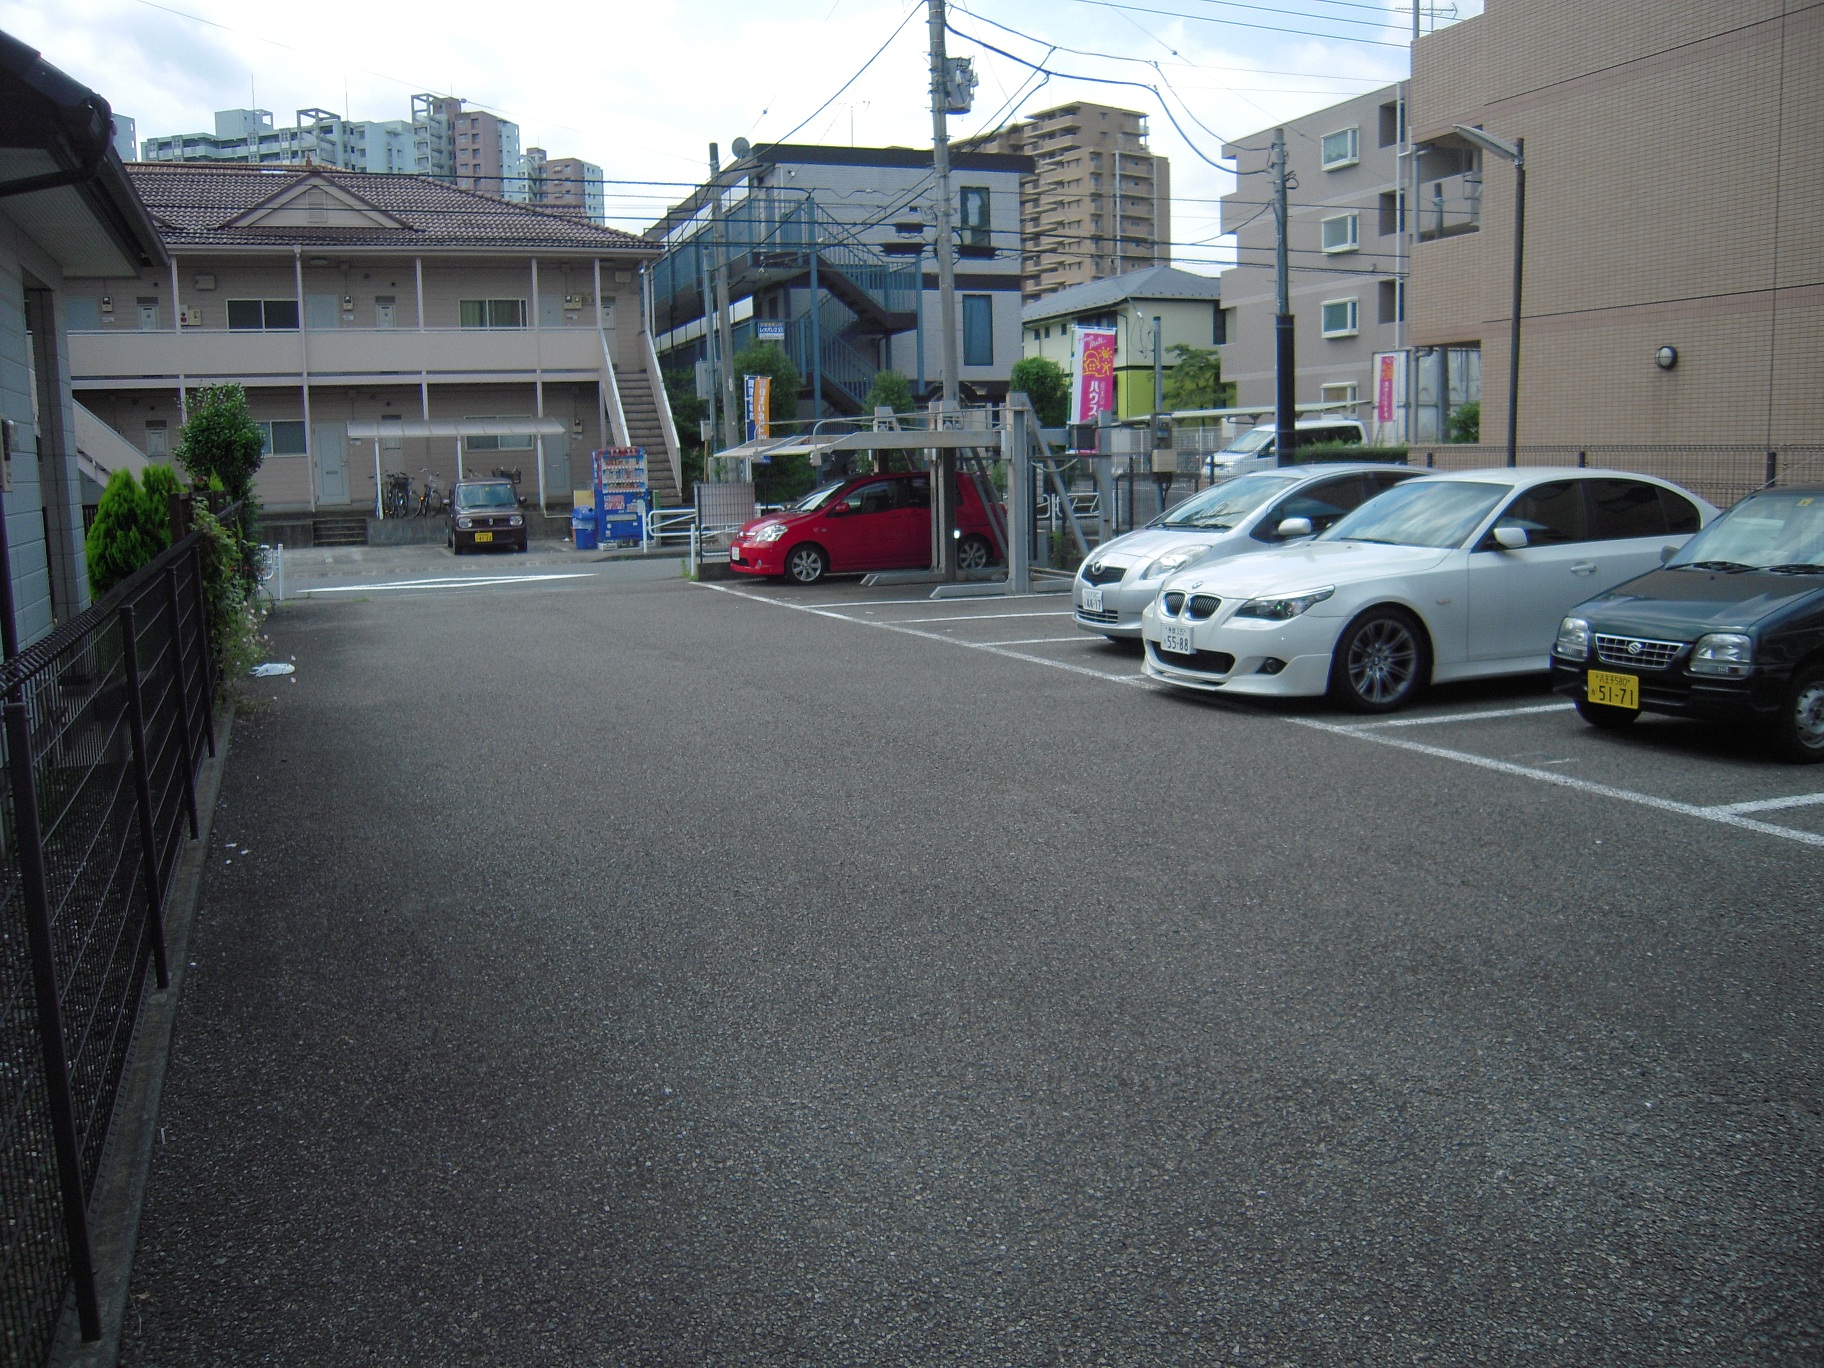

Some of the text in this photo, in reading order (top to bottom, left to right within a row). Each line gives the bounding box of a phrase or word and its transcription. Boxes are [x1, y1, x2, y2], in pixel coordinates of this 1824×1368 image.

[1088, 380, 1100, 419] ハウス
[1167, 635, 1189, 652] 55-88
[1599, 685, 1633, 706] 51-71
